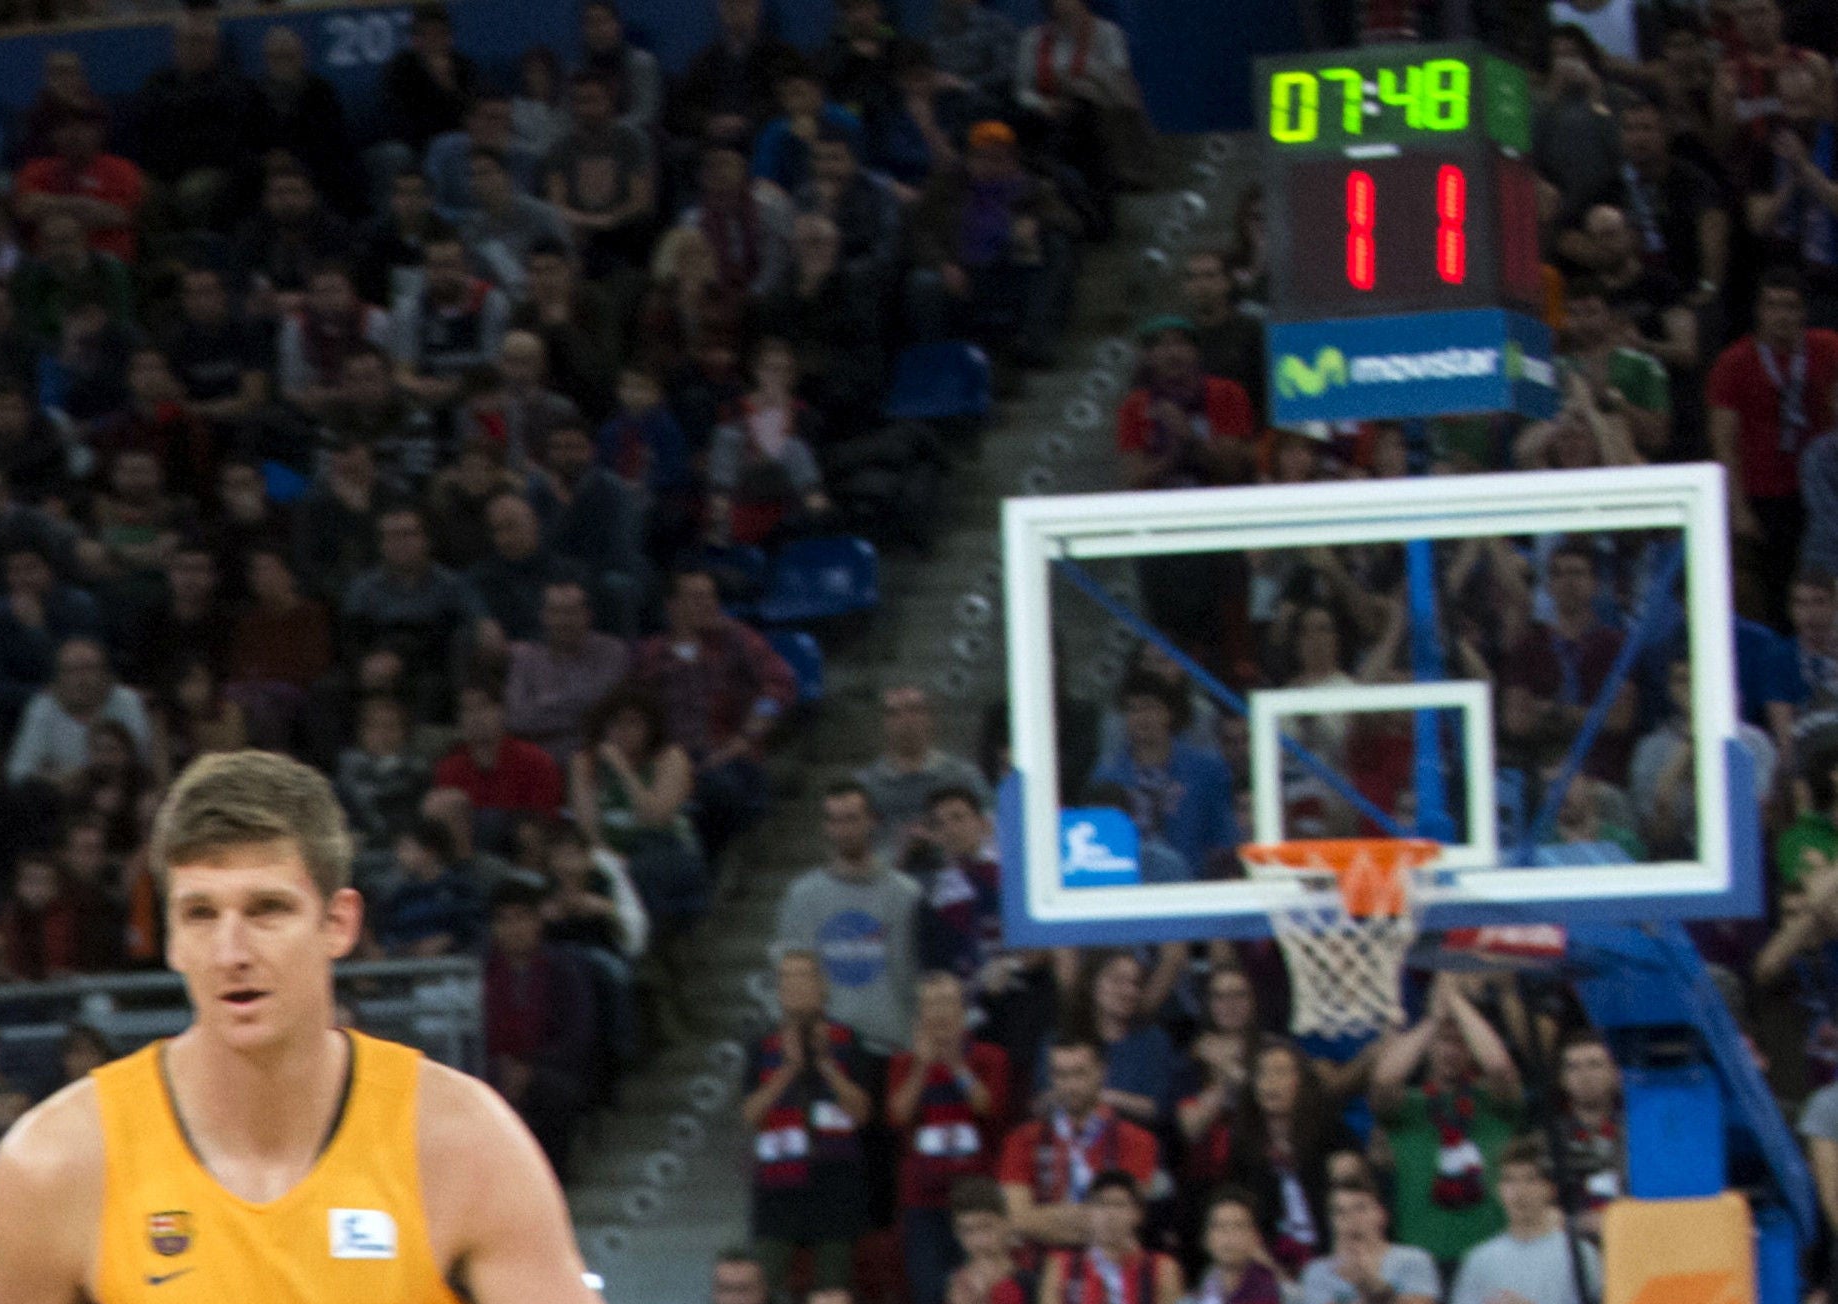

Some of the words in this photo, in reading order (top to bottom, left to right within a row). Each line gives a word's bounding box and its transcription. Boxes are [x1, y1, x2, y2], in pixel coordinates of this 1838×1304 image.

[325, 12, 416, 64] 20
[1270, 59, 1470, 144] 07:48
[1346, 163, 1467, 291] 11
[1349, 345, 1499, 383] movistar
